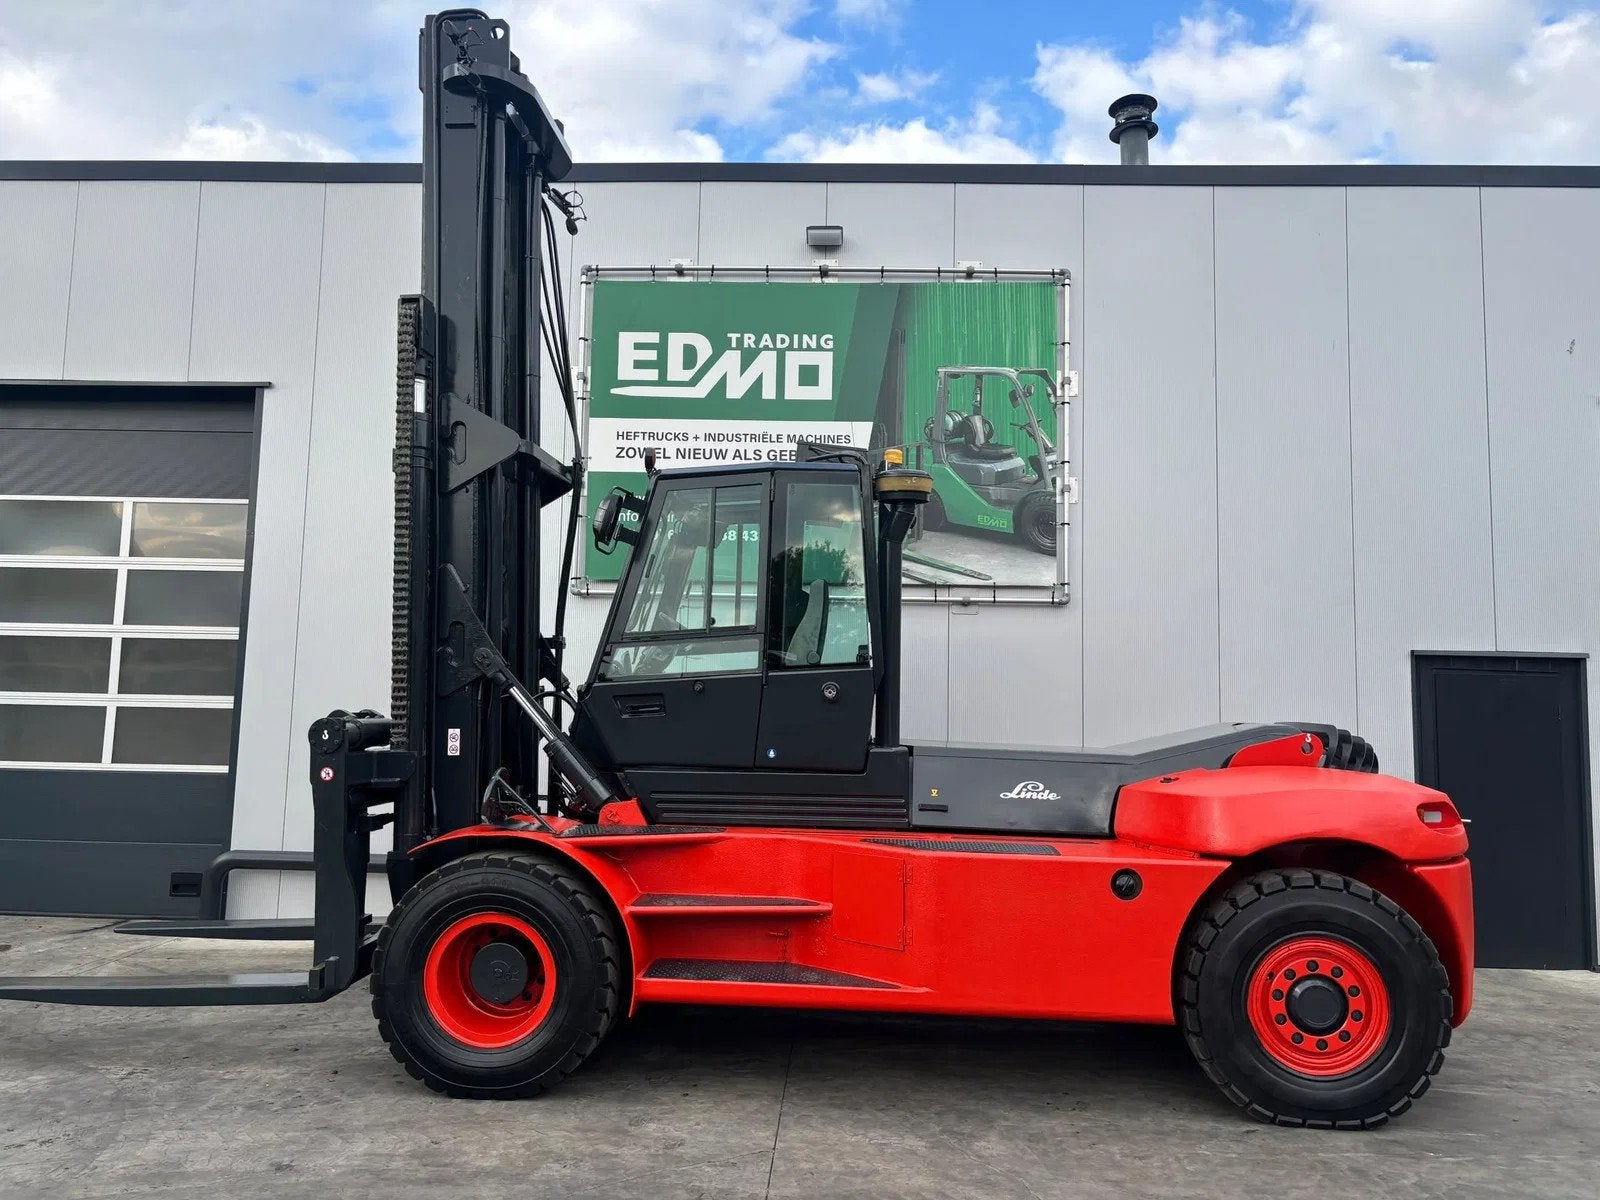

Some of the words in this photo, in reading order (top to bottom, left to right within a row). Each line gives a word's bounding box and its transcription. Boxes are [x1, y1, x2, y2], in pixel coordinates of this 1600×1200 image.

[727, 333, 834, 349] TRADING
[610, 331, 834, 401] EDMO
[616, 431, 689, 442] HEFTRUCKS
[693, 434, 700, 442] +
[704, 432, 784, 444] INDUSTRIËLE
[786, 434, 851, 444] MACHINES
[675, 448, 728, 461] NIEUW
[732, 449, 763, 461] ALS
[619, 510, 639, 522] nfo
[977, 514, 1008, 529] EDMO
[1000, 780, 1061, 801] Linde
